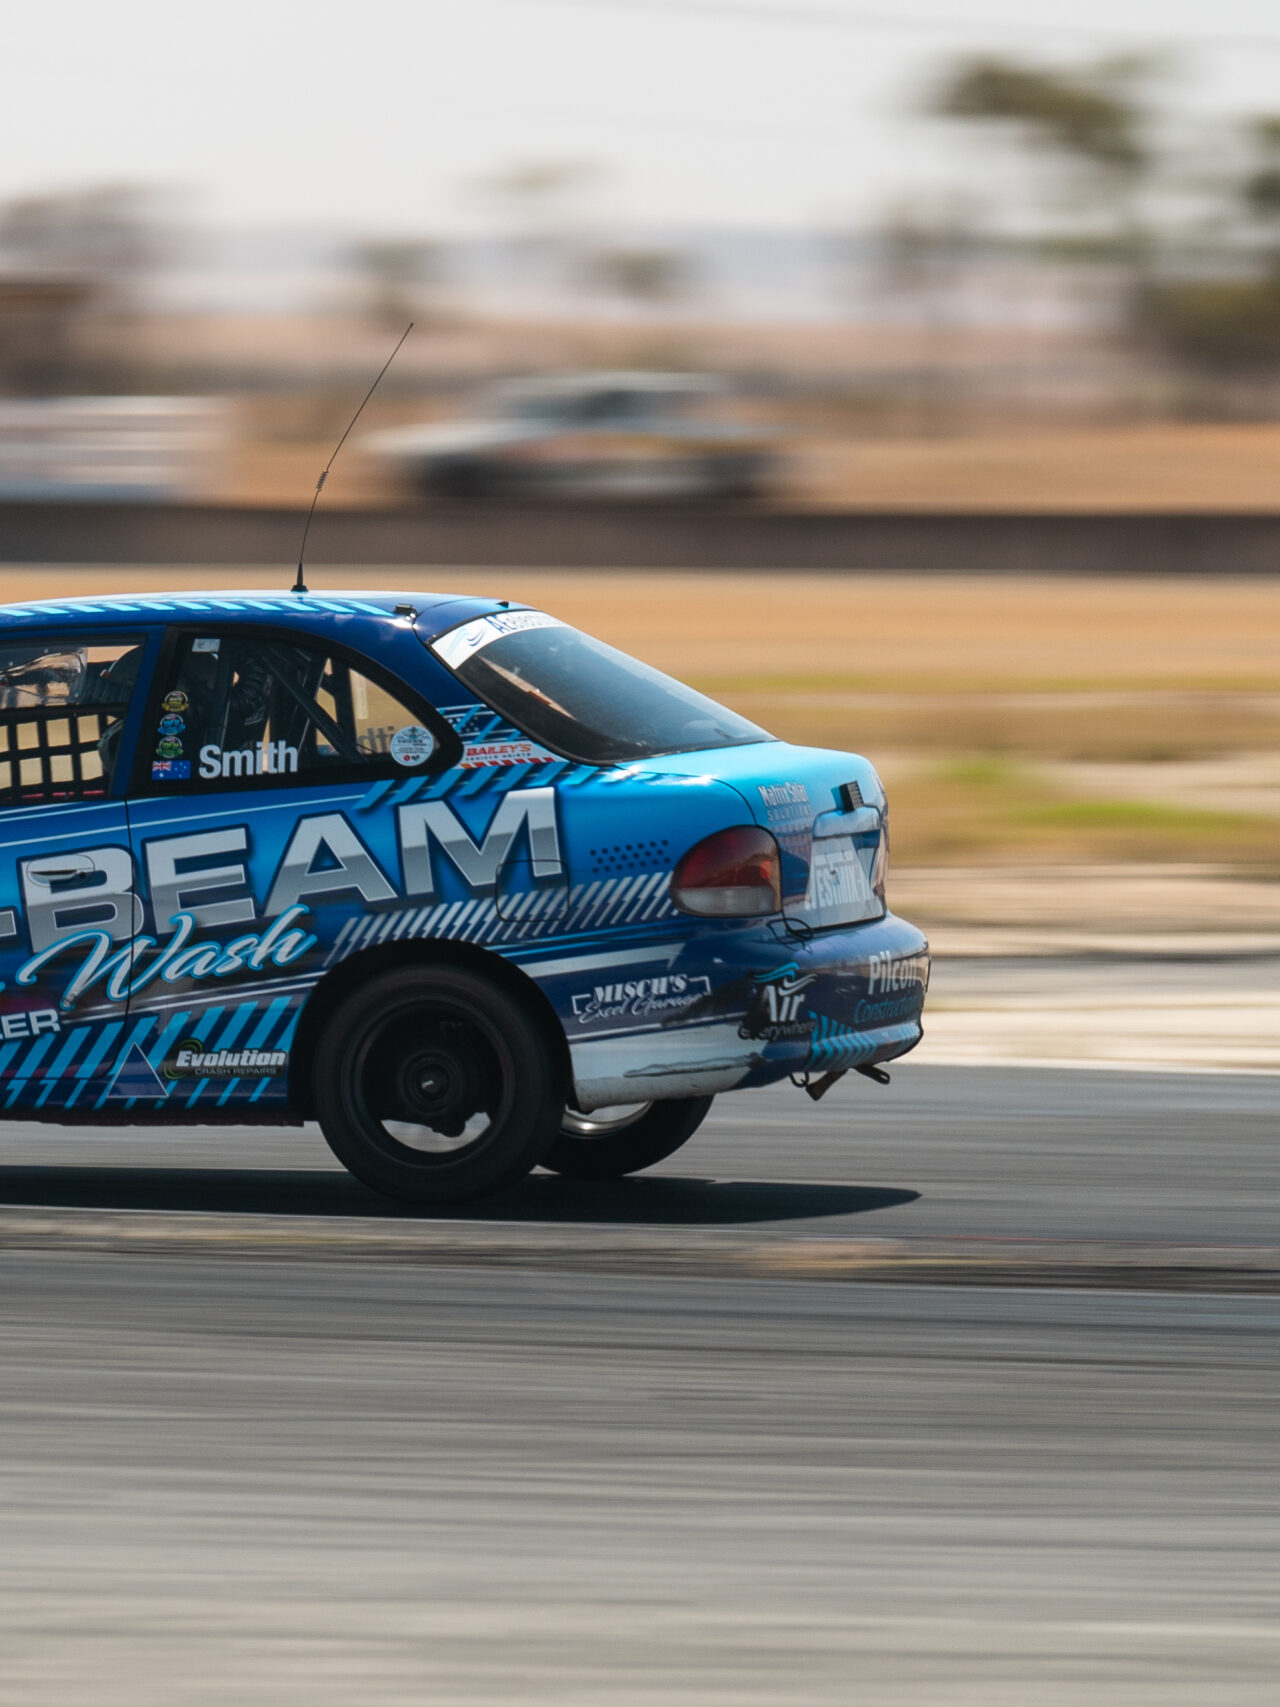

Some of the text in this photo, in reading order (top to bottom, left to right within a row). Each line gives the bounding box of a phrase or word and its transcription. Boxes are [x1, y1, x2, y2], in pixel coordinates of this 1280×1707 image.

[199, 740, 298, 779] Smith
[466, 743, 532, 757] BAILEY'S
[15, 903, 317, 1010] Wash
[868, 951, 917, 996] Pilcon
[593, 974, 688, 1003] MISCH'S
[761, 984, 806, 1023] Air
[176, 1050, 287, 1068] Evolution
[195, 1066, 277, 1076] CRASH REPAIRS
